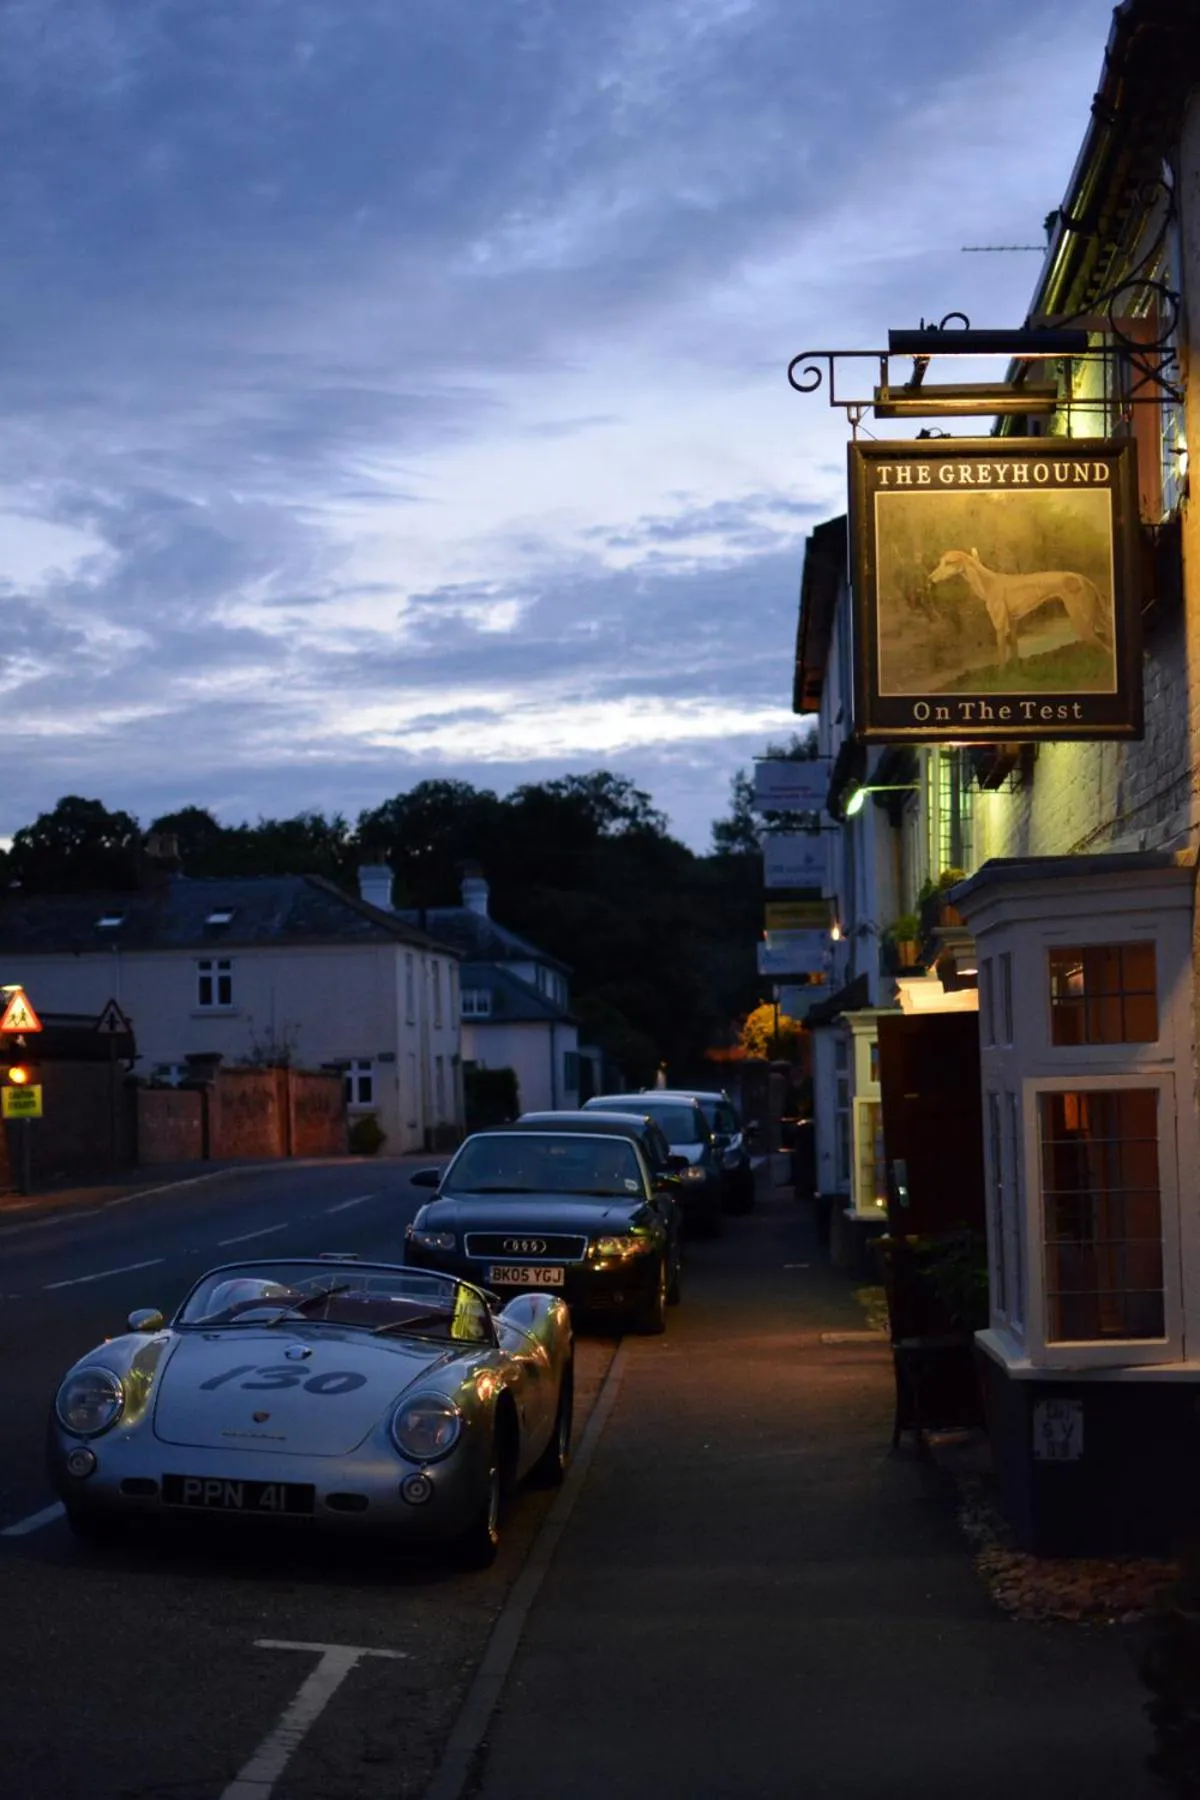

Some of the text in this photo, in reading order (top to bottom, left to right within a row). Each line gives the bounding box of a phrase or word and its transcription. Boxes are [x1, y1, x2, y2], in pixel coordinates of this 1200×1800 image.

[876, 462, 1110, 484] THE GREYHOUND
[913, 701, 1083, 721] On The Test
[492, 1267, 562, 1283] BK05 YGJ
[199, 1364, 368, 1395] 130
[182, 1478, 287, 1511] PPN 41
